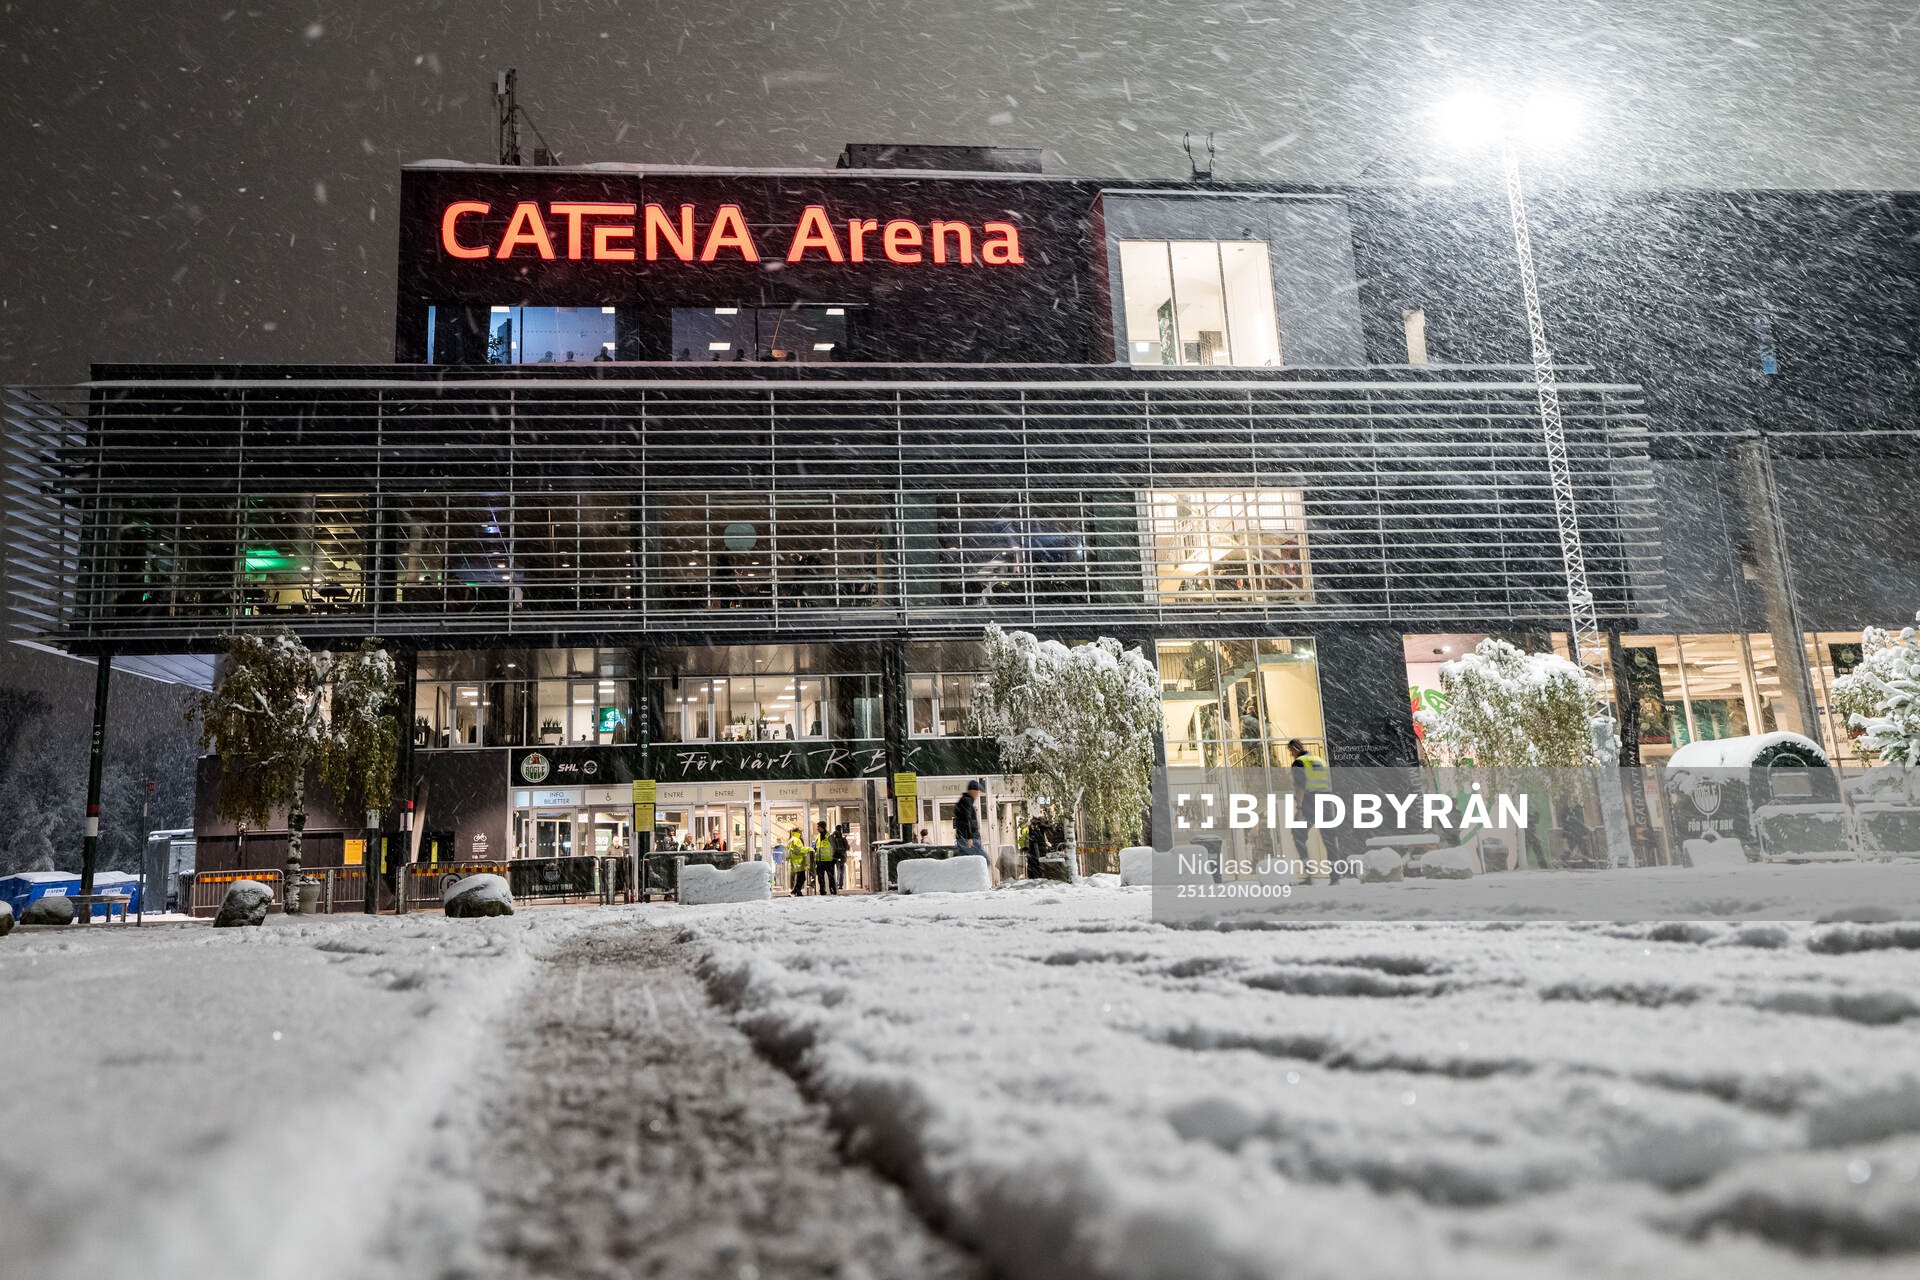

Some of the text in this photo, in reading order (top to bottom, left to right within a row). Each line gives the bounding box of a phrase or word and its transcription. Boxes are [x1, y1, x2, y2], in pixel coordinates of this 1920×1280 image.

[441, 201, 1025, 264] CATENA Arena
[640, 743, 649, 757] BK
[558, 763, 579, 773] SHL
[676, 751, 723, 777] För
[740, 750, 801, 770] vårt
[1719, 819, 1734, 831] RBK
